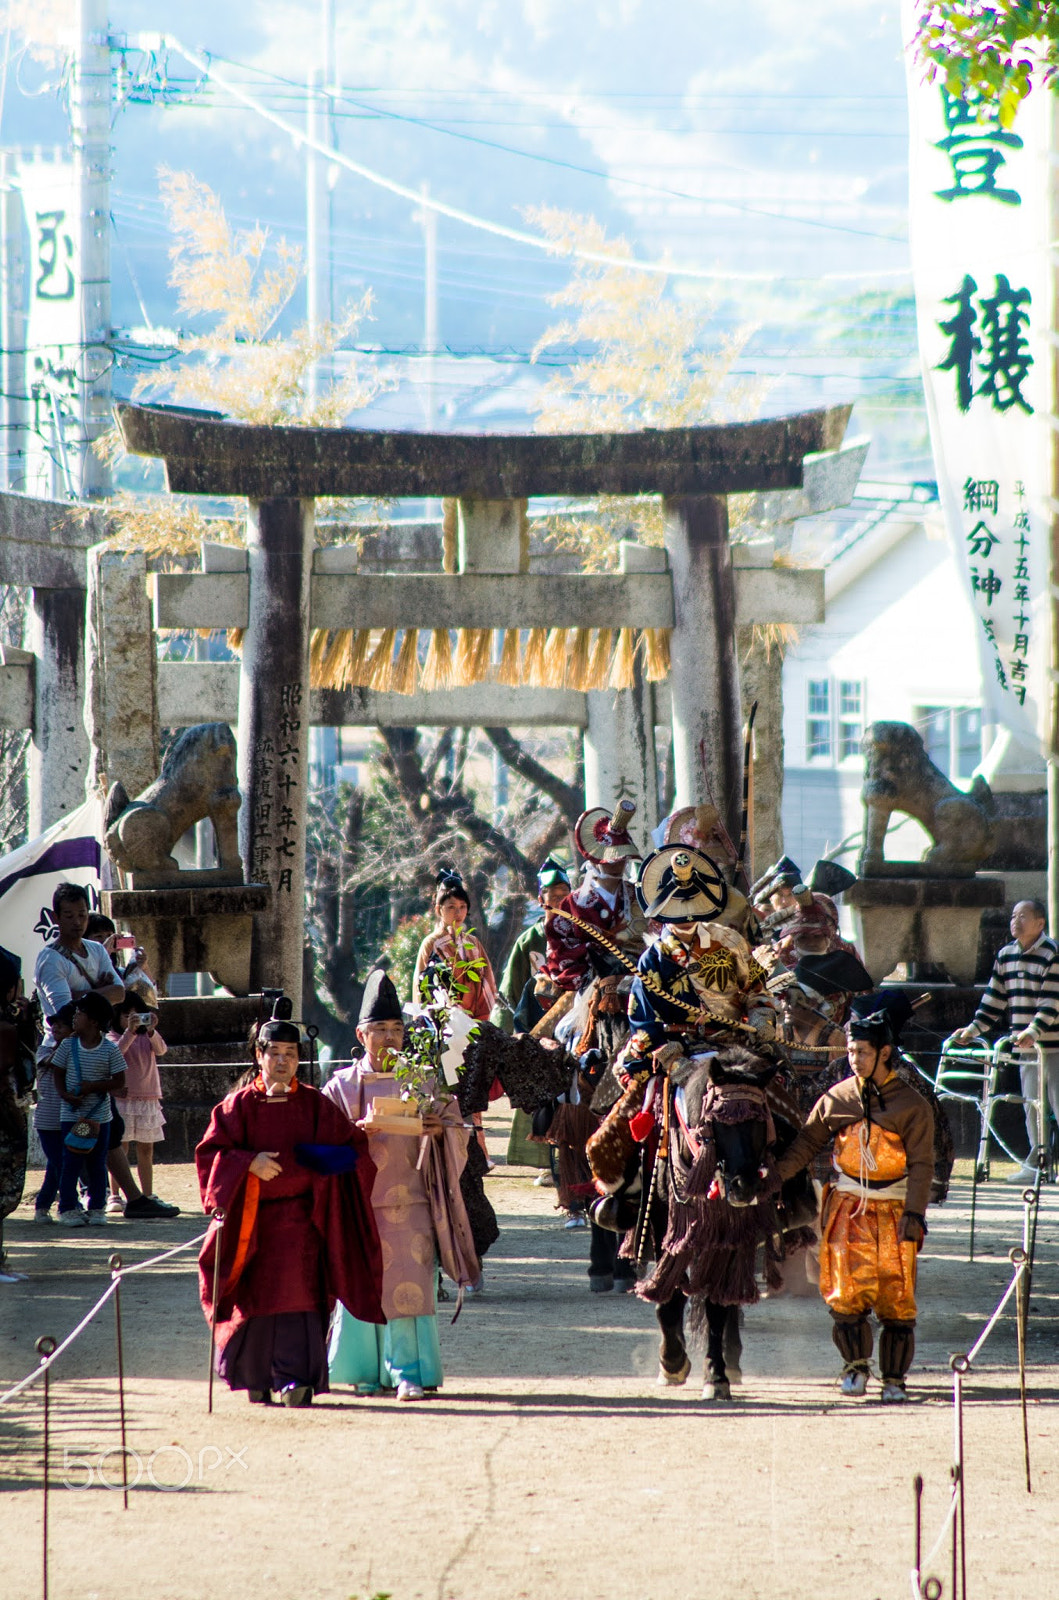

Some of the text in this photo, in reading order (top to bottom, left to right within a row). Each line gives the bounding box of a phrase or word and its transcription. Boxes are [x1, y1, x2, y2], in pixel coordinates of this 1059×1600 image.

[276, 683, 302, 894] 昭和六十年七月
